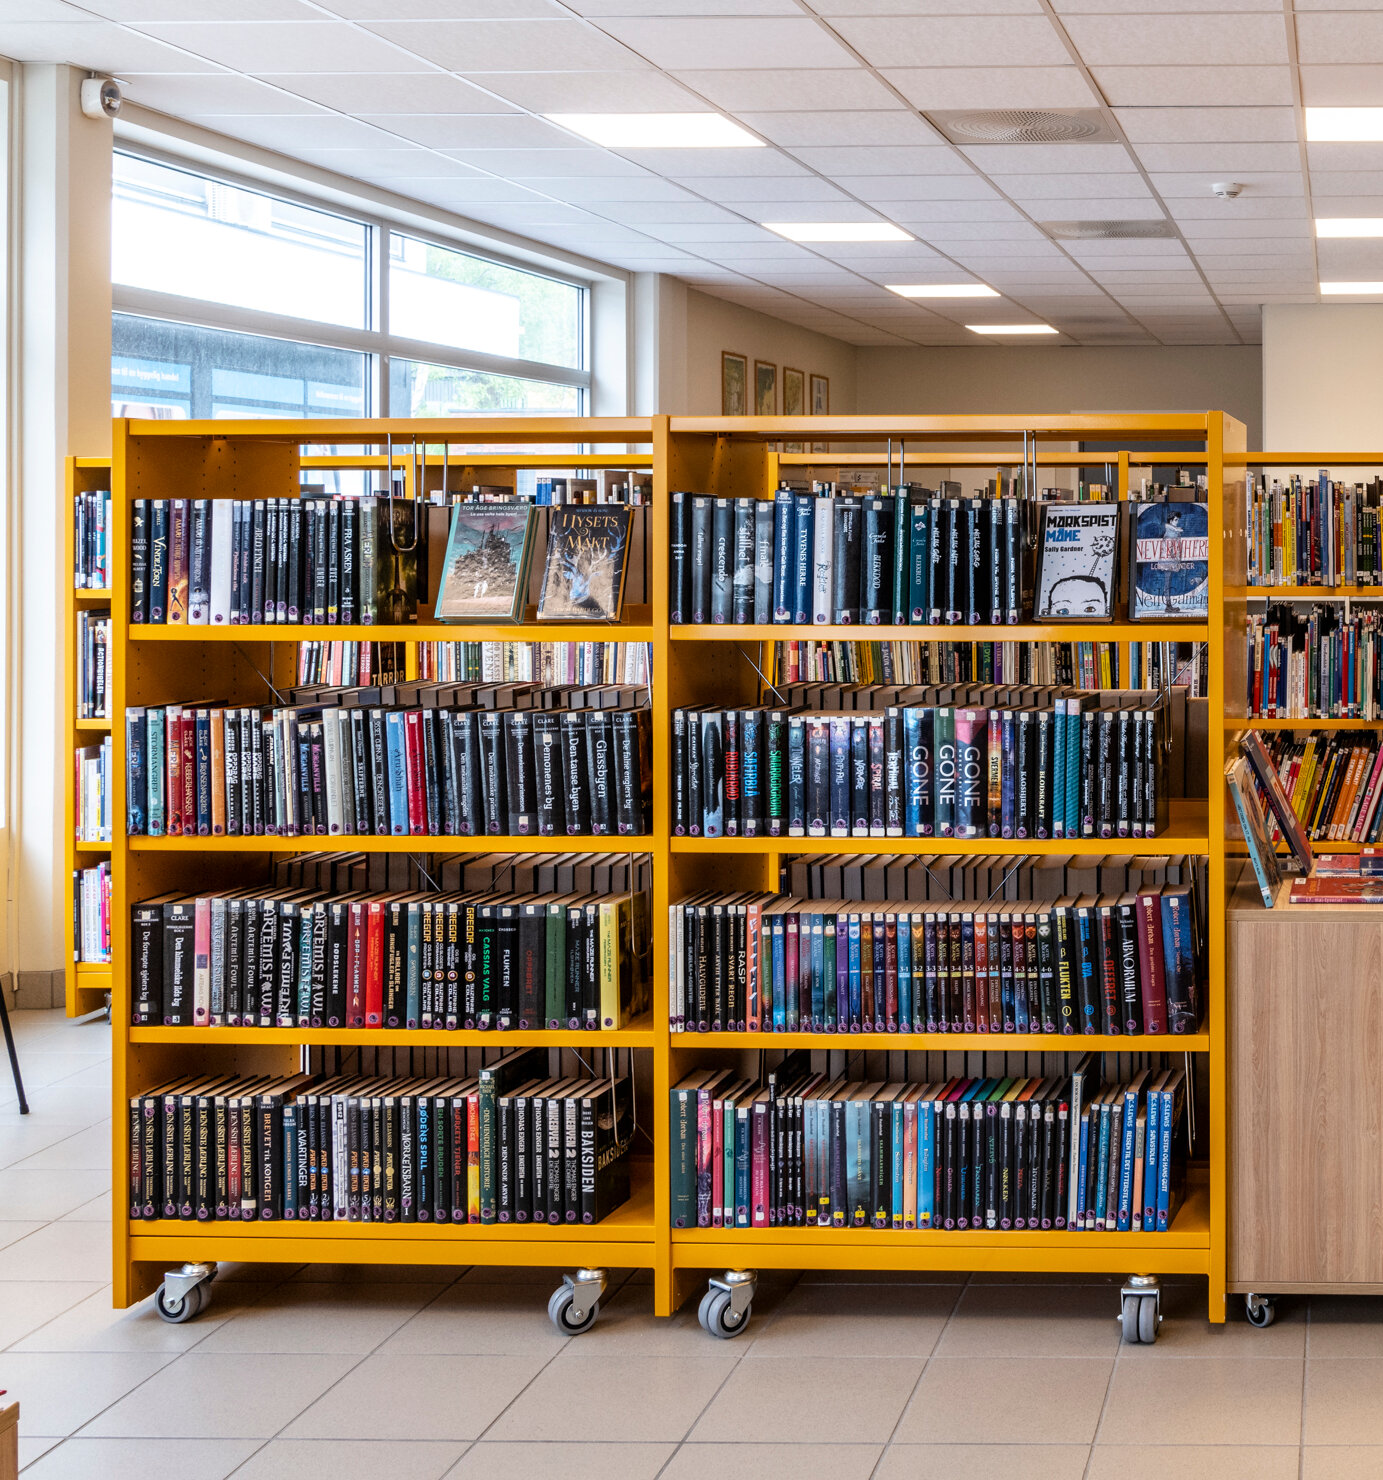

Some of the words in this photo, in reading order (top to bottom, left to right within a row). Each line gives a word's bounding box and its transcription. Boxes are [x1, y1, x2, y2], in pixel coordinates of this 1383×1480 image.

[476, 503, 487, 511] ÅGE
[1046, 528, 1080, 542] MÅNE
[1047, 515, 1117, 528] MARKSPIST
[254, 527, 263, 548] ARLO
[344, 529, 352, 545] FRA
[564, 535, 610, 550] MAKT
[696, 531, 704, 549] fallen
[738, 527, 751, 562] stillhet
[800, 529, 808, 562] TYVENES
[255, 549, 263, 573] FINCH
[344, 546, 352, 574] ASKEN
[717, 537, 729, 582] crescendo
[759, 541, 770, 568] finale
[329, 567, 337, 583] OVER
[799, 563, 808, 587] HERRE
[459, 753, 467, 765] Den
[488, 752, 496, 765] Den
[517, 742, 525, 754] Den
[568, 738, 580, 758] Den
[622, 740, 631, 750] De
[299, 743, 311, 793] MORGANVILLE
[311, 744, 322, 793] MORGANVILLE
[542, 741, 554, 796] Demonenes
[569, 759, 579, 784] tause
[595, 740, 608, 799] Glassbyen
[724, 751, 740, 801] RUBINRØD
[743, 751, 761, 798] SAFIRBLÅ
[789, 746, 804, 785] TUNNELER
[870, 762, 883, 793] SPIRAL
[886, 750, 902, 793] TERMINAL
[912, 745, 929, 807] GONE
[939, 744, 955, 806] GONE
[963, 746, 981, 808] GONE
[459, 766, 468, 794] mekaniske
[488, 766, 497, 794] mekaniske
[621, 771, 633, 798] englers
[768, 750, 783, 817] SMARAGDGRØNN
[1019, 770, 1028, 818] KAOSHJERTE
[459, 795, 469, 817] engelen
[488, 796, 499, 820] prinsen
[543, 797, 555, 810] by
[569, 786, 582, 812] byen
[623, 799, 634, 810] by
[1038, 770, 1047, 819] BLODSKRAFT
[143, 931, 151, 941] De
[466, 907, 475, 943] GREGOR
[141, 941, 151, 969] fortapte
[173, 937, 184, 951] Den
[230, 926, 239, 963] ARTEMIS
[247, 926, 256, 963] ARTEMIS
[301, 920, 313, 977] ARTEMIS
[312, 911, 327, 971] ARTEMIS
[353, 939, 361, 953] OPP
[173, 951, 185, 985] himmelske
[332, 943, 340, 995] DØDSLEKENE
[482, 936, 491, 976] CASSIAS
[502, 949, 511, 988] FLUKTEN
[727, 954, 736, 982] SVART
[738, 951, 747, 985] RASP
[140, 970, 150, 991] sjelers
[230, 964, 238, 989] FOWL
[247, 964, 256, 989] FOWL
[353, 960, 361, 994] FLAMMER
[698, 955, 707, 1012] HALVGUDENE
[1058, 961, 1072, 1000] FLUKTEN
[1103, 960, 1117, 1001] OFFERET
[1122, 938, 1137, 1003] ABNORMIUM
[139, 992, 149, 1001] by
[171, 998, 182, 1007] by
[482, 977, 491, 1002] VALG
[727, 984, 736, 1009] REGN
[263, 1113, 272, 1148] BREVET
[482, 1124, 491, 1159] UENDELIGE
[182, 1144, 192, 1175] LÆRLING
[199, 1147, 208, 1178] LÆRLING
[215, 1144, 225, 1175] LÆRLING
[297, 1129, 308, 1187] KVARTINGER
[420, 1144, 428, 1171] SPILL
[566, 1149, 577, 1158] 2
[581, 1130, 595, 1194] BAKSIDEN
[483, 1160, 491, 1189] HISTORIE
[501, 1183, 509, 1206] ARVEN
